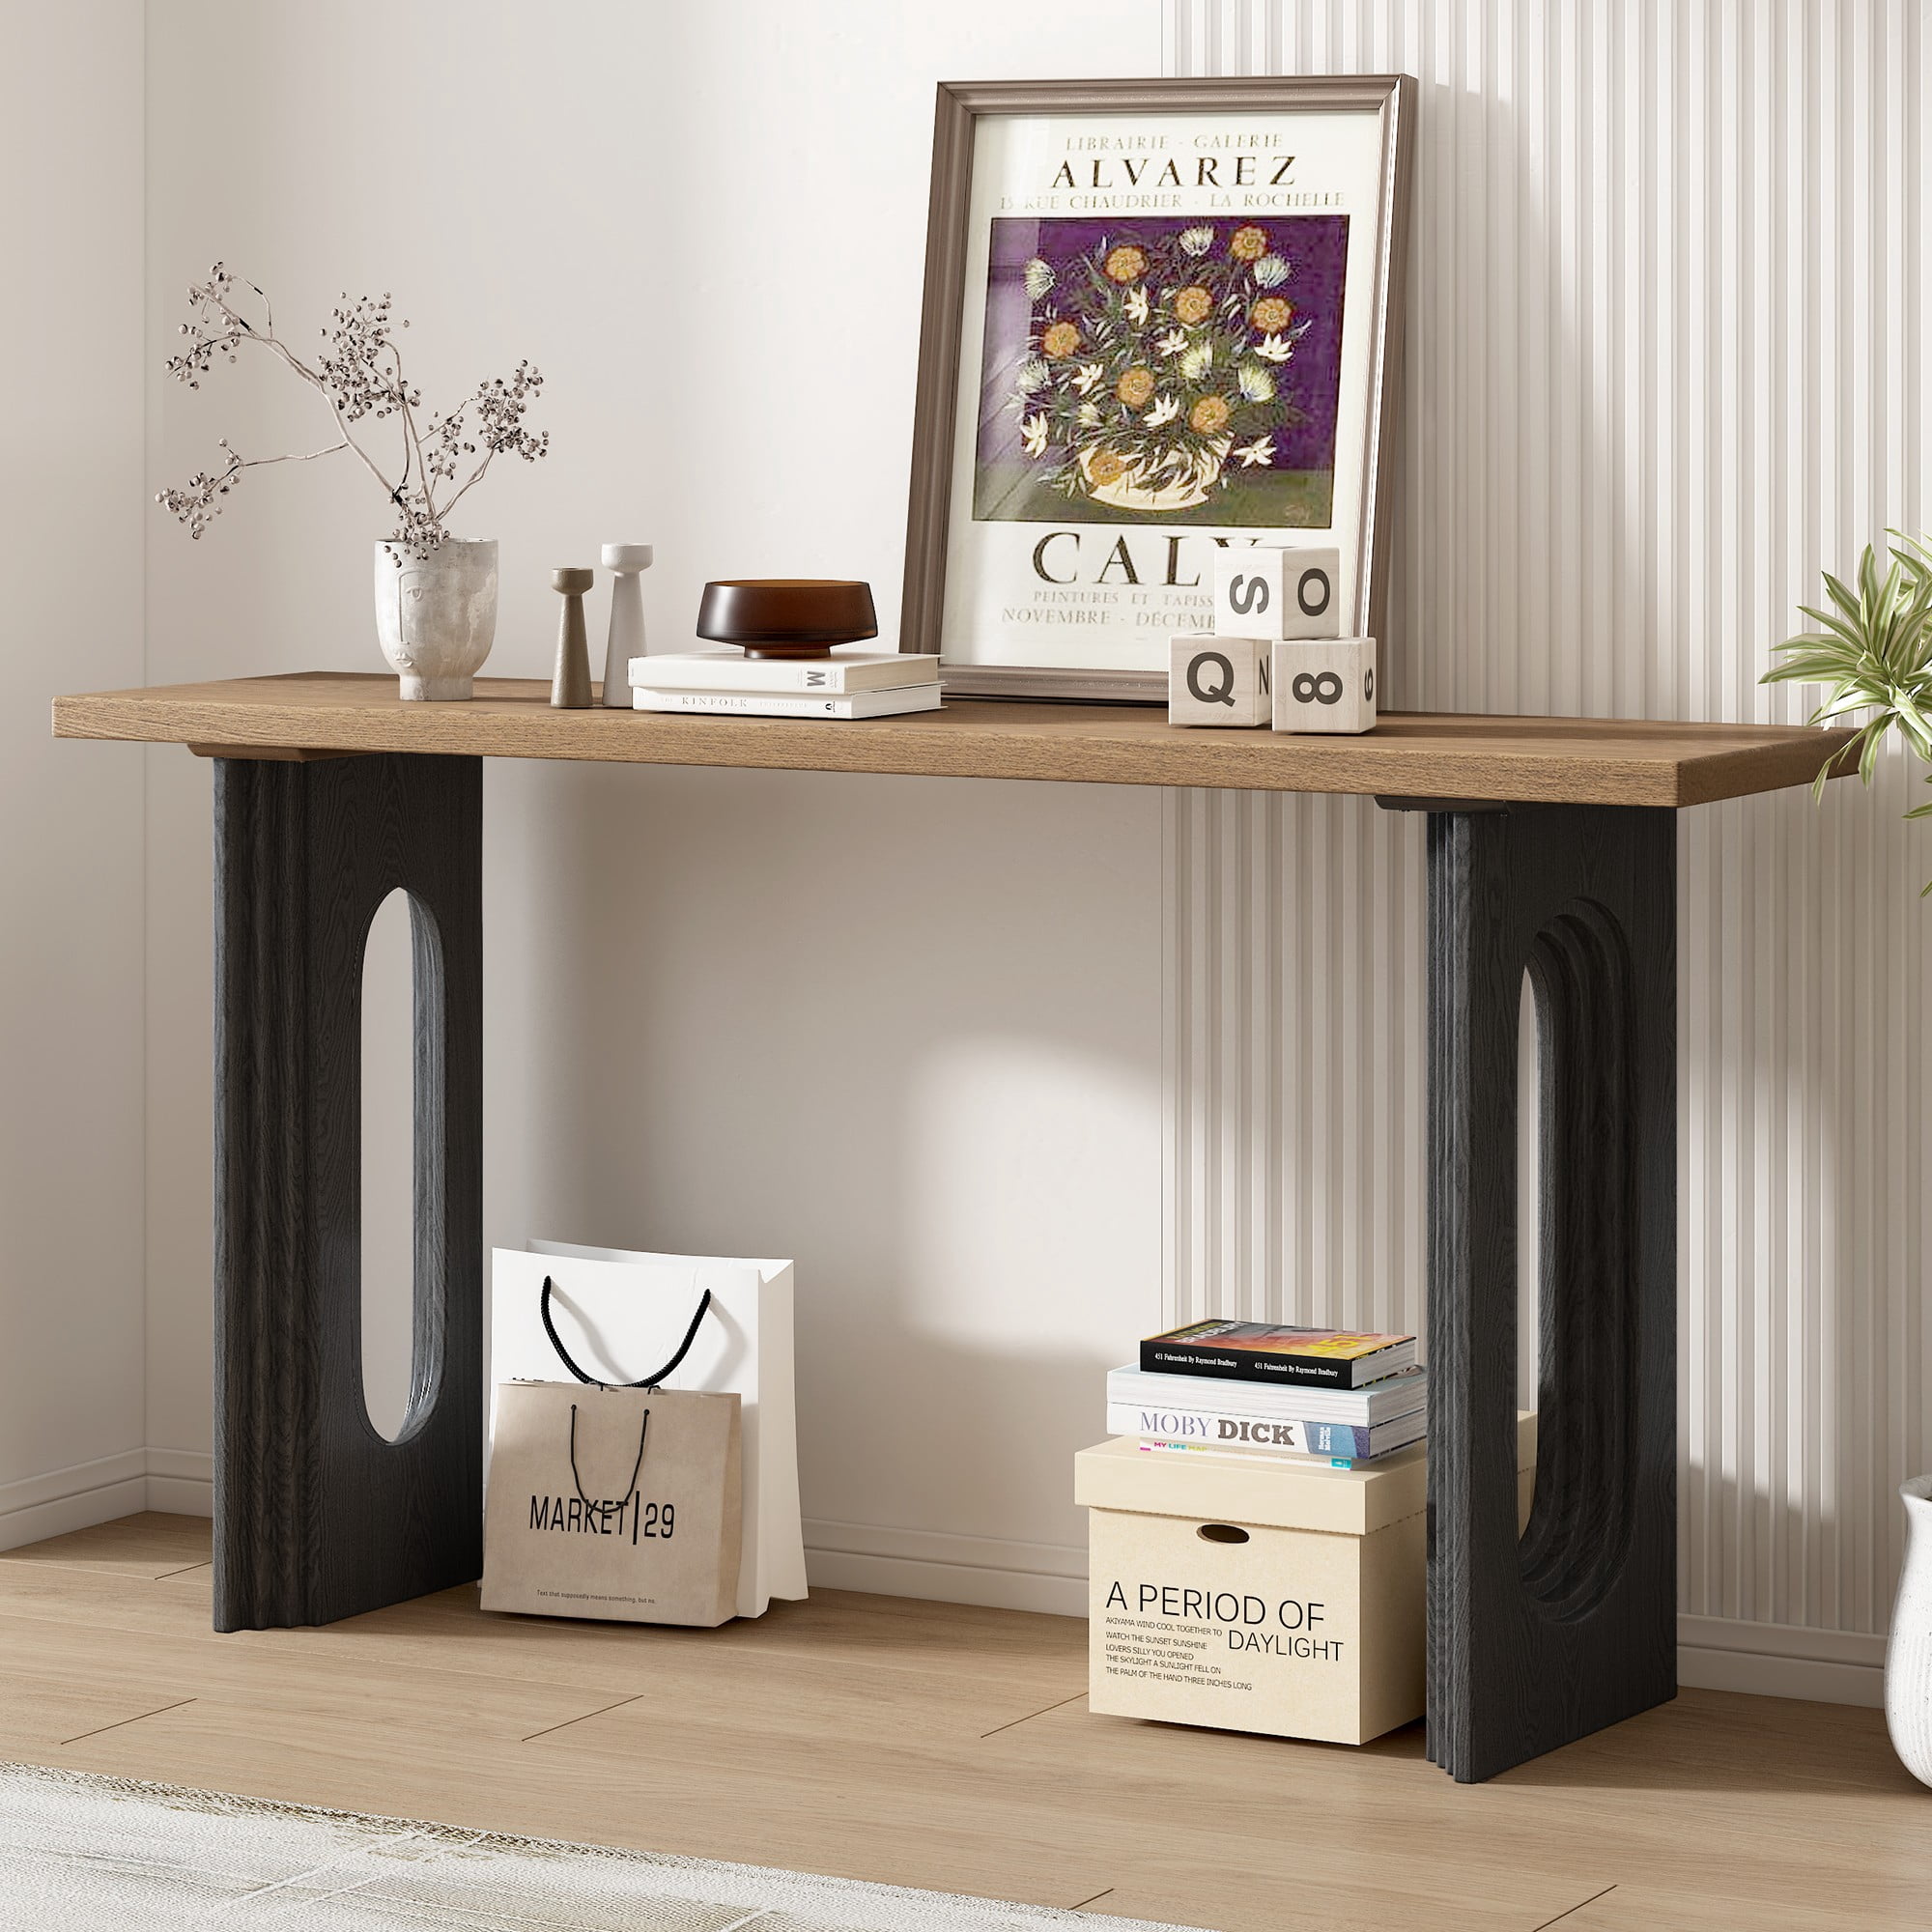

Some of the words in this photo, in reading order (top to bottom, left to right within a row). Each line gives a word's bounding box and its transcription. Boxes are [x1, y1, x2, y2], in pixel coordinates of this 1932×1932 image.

[1065, 135, 1169, 151] LIBRAIRIE
[1193, 132, 1283, 149] GALERIE
[1050, 156, 1297, 188] ALVAREZ
[1024, 195, 1060, 210] RUE
[1069, 193, 1183, 210] CHAUDRIER
[1209, 192, 1233, 208] LA
[1243, 191, 1346, 207] ROCHELLE
[1032, 531, 1263, 587] CAL
[1034, 590, 1119, 604] PEINTURES
[1132, 592, 1149, 606] ET
[1229, 574, 1270, 615] S
[1003, 608, 1111, 625] NOVEMBRE
[807, 670, 826, 687] M
[1186, 651, 1236, 708] Q
[1292, 671, 1344, 706] 8
[682, 696, 749, 707] KINFOLK
[1154, 1352, 1163, 1361] 451
[1164, 1353, 1188, 1363] Fahrenheit
[1188, 1356, 1195, 1365] By
[1195, 1356, 1217, 1367] Raymond
[1217, 1358, 1237, 1368] Bradbury
[1254, 1361, 1264, 1371] 451
[1264, 1362, 1288, 1373] Fahrenheit
[1288, 1365, 1295, 1374] By
[1295, 1365, 1318, 1376] Raymond
[1318, 1368, 1339, 1378] Bradbury
[1140, 1411, 1211, 1437] MOBY
[1217, 1418, 1295, 1446] DICK
[529, 1494, 629, 1535] MARKET
[1106, 1580, 1128, 1611] A
[1139, 1583, 1266, 1626] PERIOD
[1278, 1600, 1325, 1632] OF
[1105, 1616, 1135, 1627] AKIYAMA
[1136, 1620, 1155, 1630] WIND
[1156, 1622, 1176, 1632] COOL
[1177, 1624, 1211, 1636] TOGETHER
[1105, 1631, 1130, 1640] WATCH
[1131, 1634, 1145, 1643] THE
[1145, 1635, 1172, 1646] SUNSET
[1173, 1638, 1208, 1650] SUNSHINE
[1229, 1630, 1344, 1662] DAYLIGHT
[1105, 1643, 1132, 1654] LOVERS
[1132, 1646, 1151, 1656] SILLY
[1151, 1648, 1166, 1659] YOU
[1167, 1650, 1194, 1661] OPENED
[1105, 1654, 1120, 1662] THE
[1120, 1656, 1152, 1667] SKYLIGHT
[1159, 1661, 1194, 1672] SUNLIGHT
[1194, 1664, 1209, 1673] FELL
[1209, 1665, 1221, 1675] ON
[1105, 1666, 1120, 1676] THE
[1120, 1667, 1138, 1677] PALM
[1138, 1670, 1149, 1679] OF
[1150, 1671, 1162, 1681] THE
[1163, 1674, 1183, 1683] HAND
[1183, 1675, 1207, 1686] THREE
[1207, 1678, 1233, 1690] INCHES
[1233, 1682, 1253, 1691] LONG
